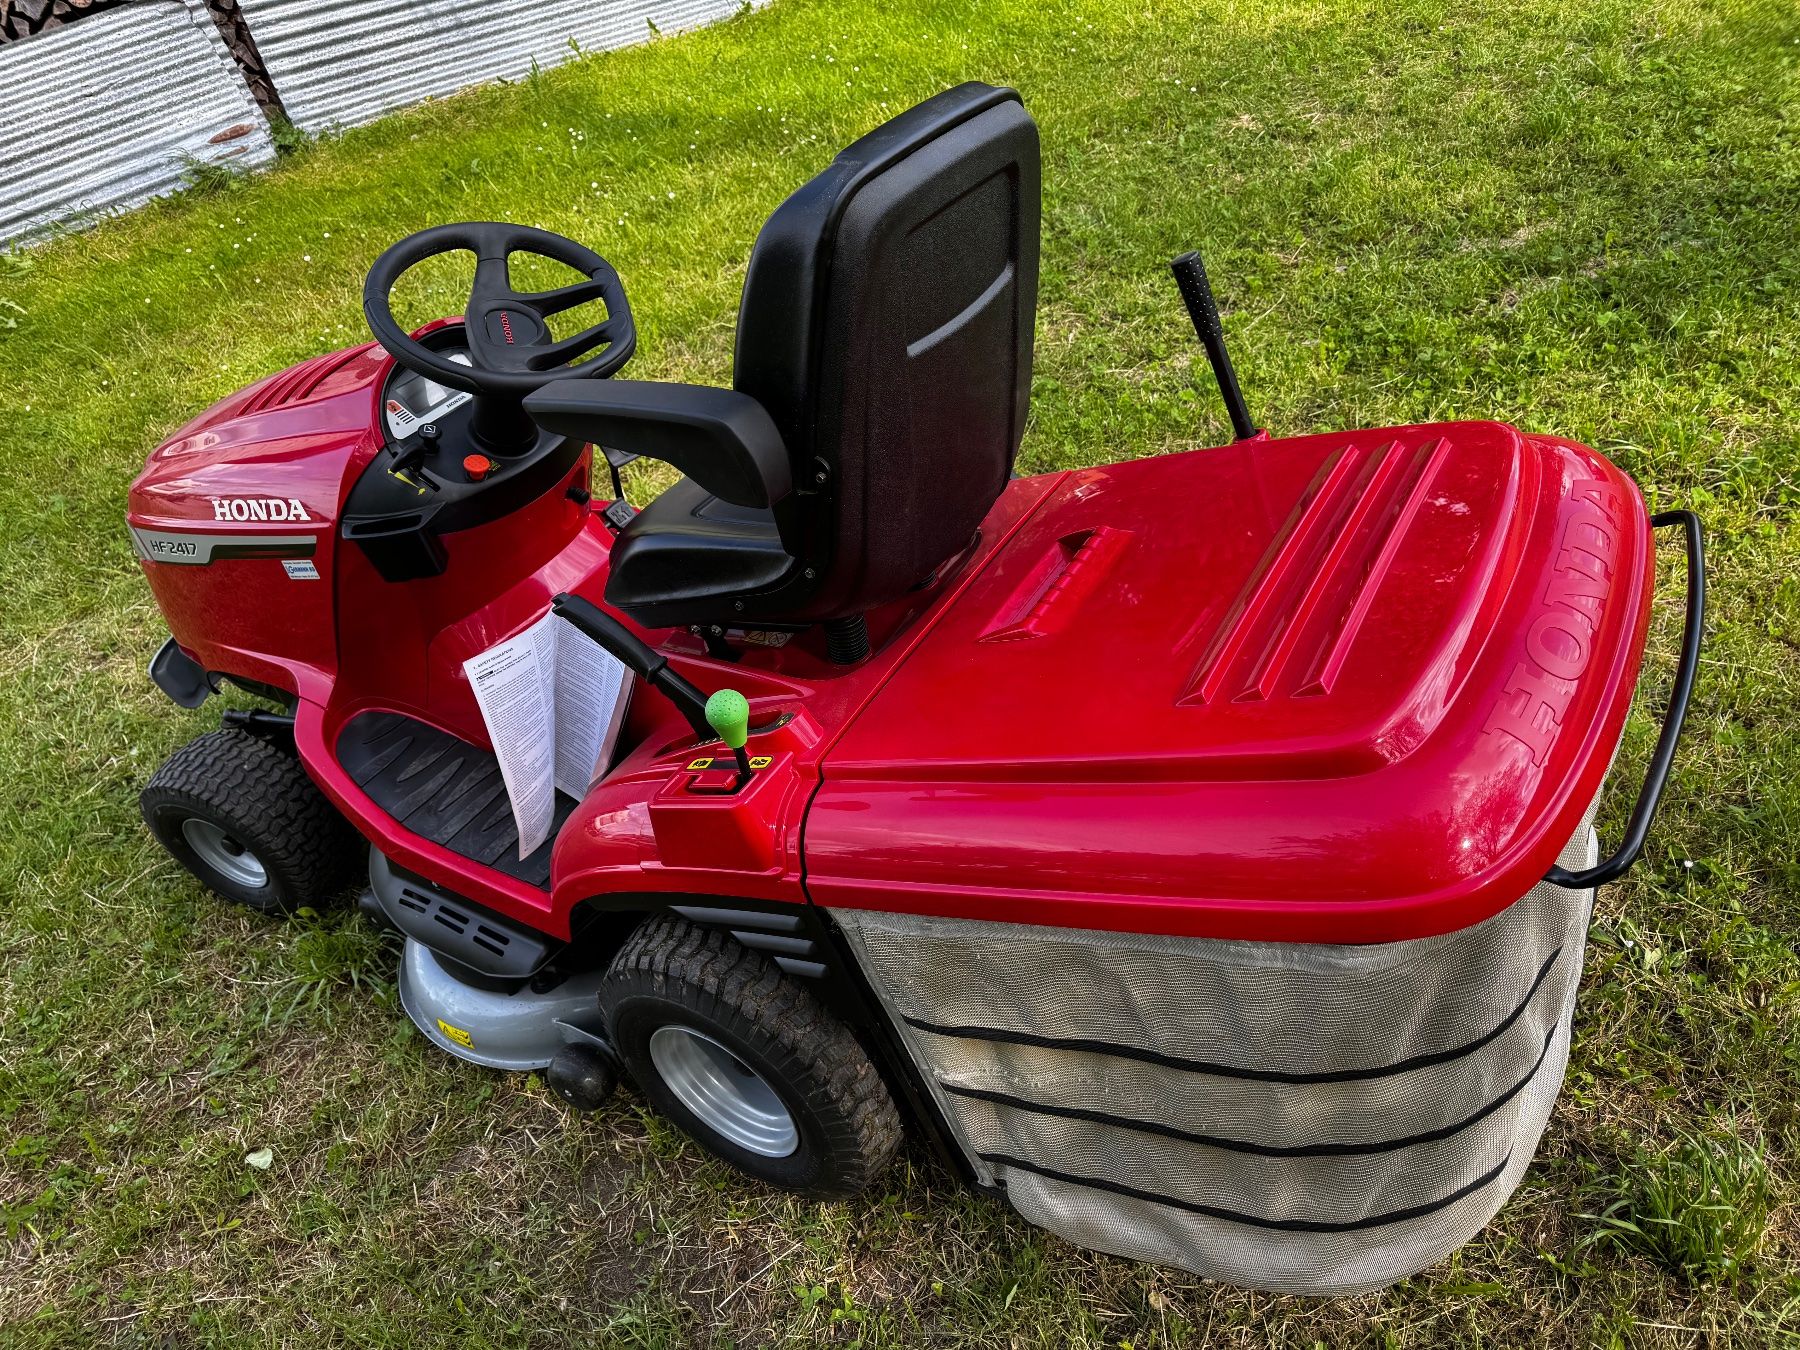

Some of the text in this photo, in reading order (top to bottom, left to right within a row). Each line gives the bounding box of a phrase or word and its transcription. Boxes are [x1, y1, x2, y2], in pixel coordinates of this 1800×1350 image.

[500, 311, 514, 344] HONDA
[211, 499, 311, 521] HONDA
[1481, 479, 1622, 768] HONDA
